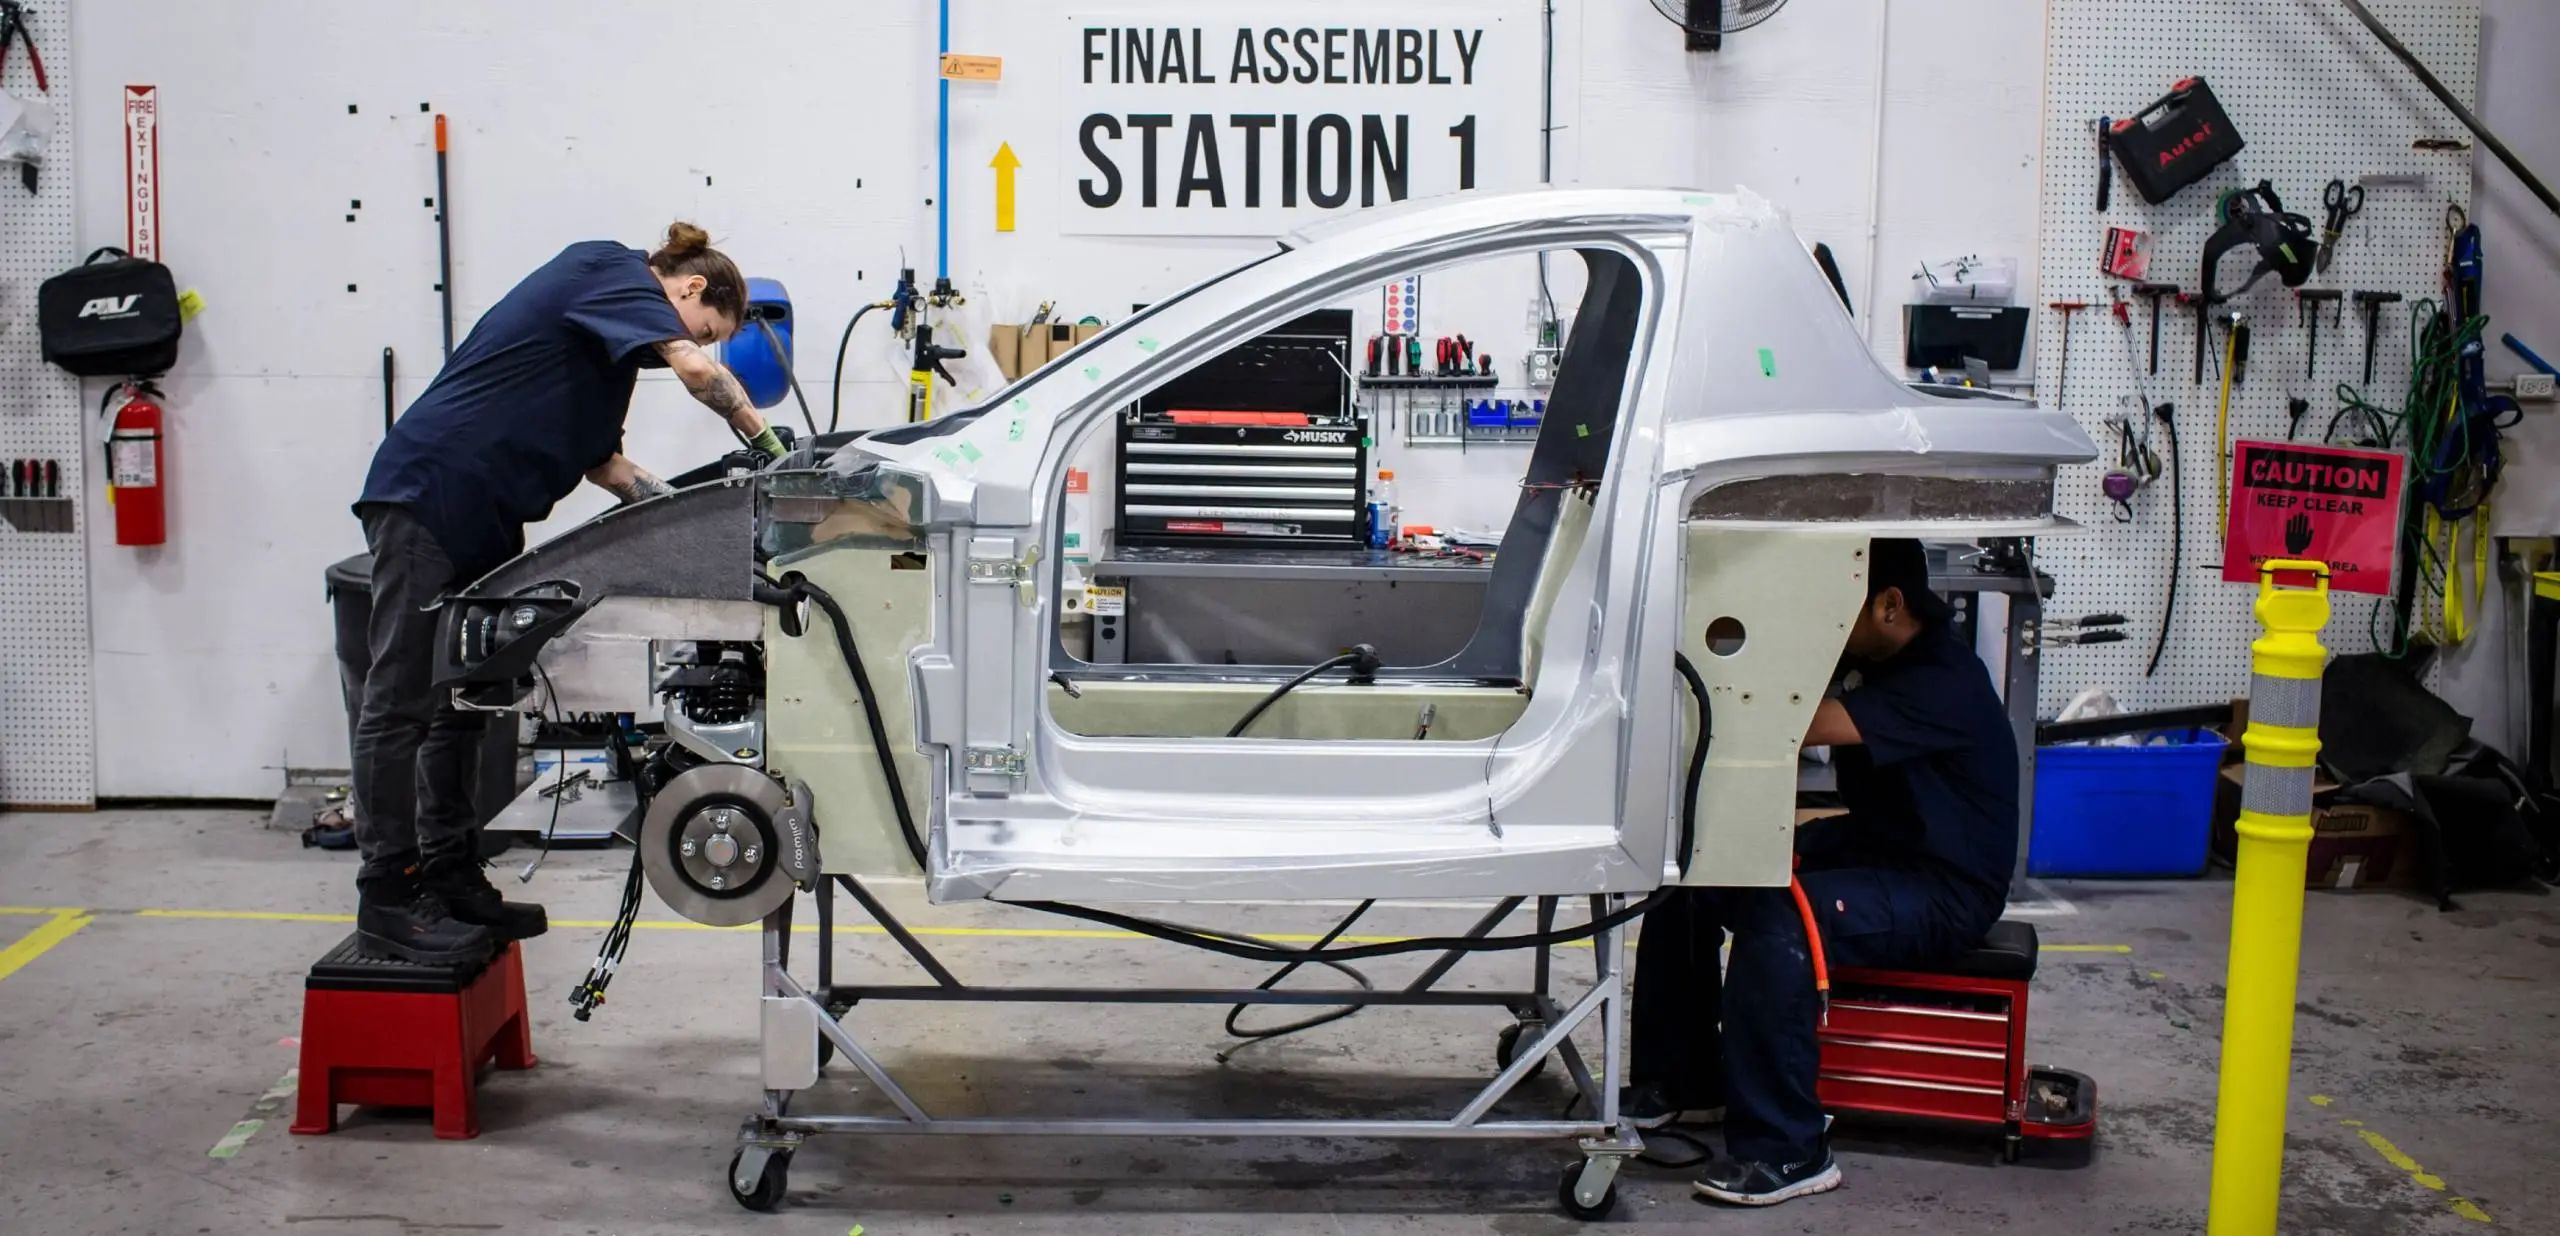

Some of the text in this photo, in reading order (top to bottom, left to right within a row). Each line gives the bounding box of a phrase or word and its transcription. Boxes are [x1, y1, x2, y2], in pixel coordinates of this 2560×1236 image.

[1083, 28, 1483, 85] FINAL ASSEMBLY
[128, 99, 153, 114] FIRE
[1078, 112, 1477, 209] STATION 1
[1300, 431, 1347, 443] HUSKY
[2250, 459, 2380, 492] CAUTION
[2256, 493, 2364, 516] KEEP CLEAR
[789, 818, 804, 870] wilwood
